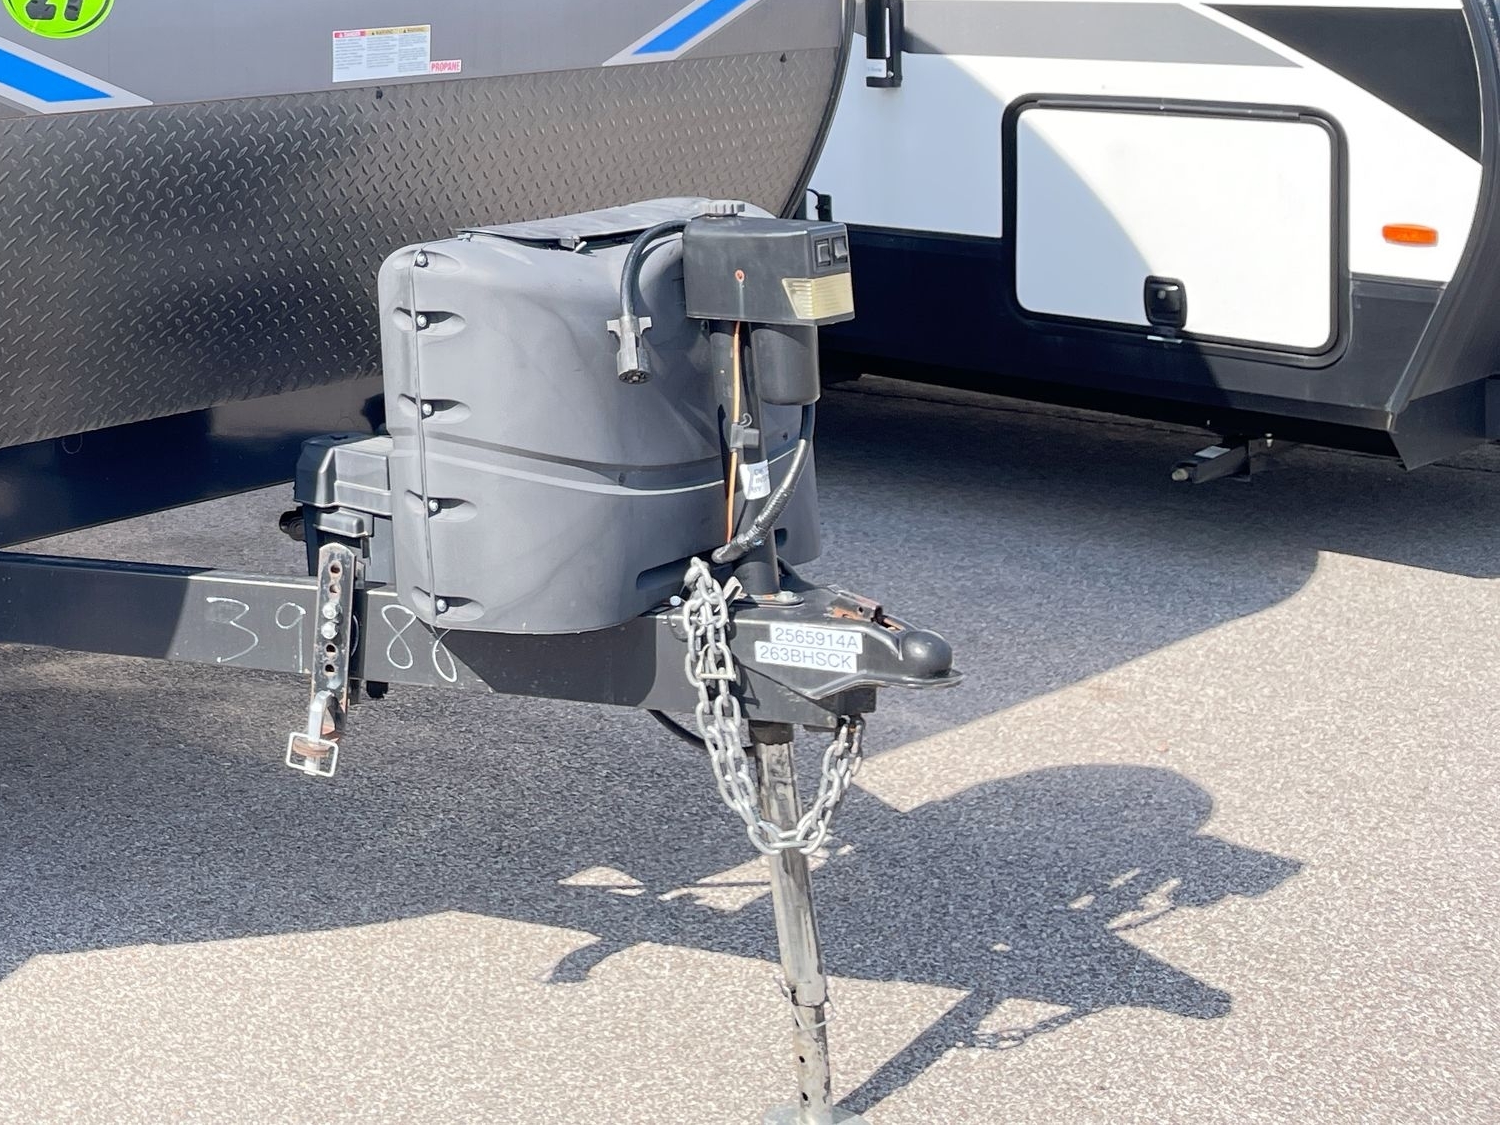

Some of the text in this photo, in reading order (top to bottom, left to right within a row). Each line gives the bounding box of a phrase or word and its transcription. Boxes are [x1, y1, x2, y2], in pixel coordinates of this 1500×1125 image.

[431, 61, 460, 72] PROPANE
[775, 628, 859, 649] 2565914A
[759, 645, 852, 669] 263BHSCK
